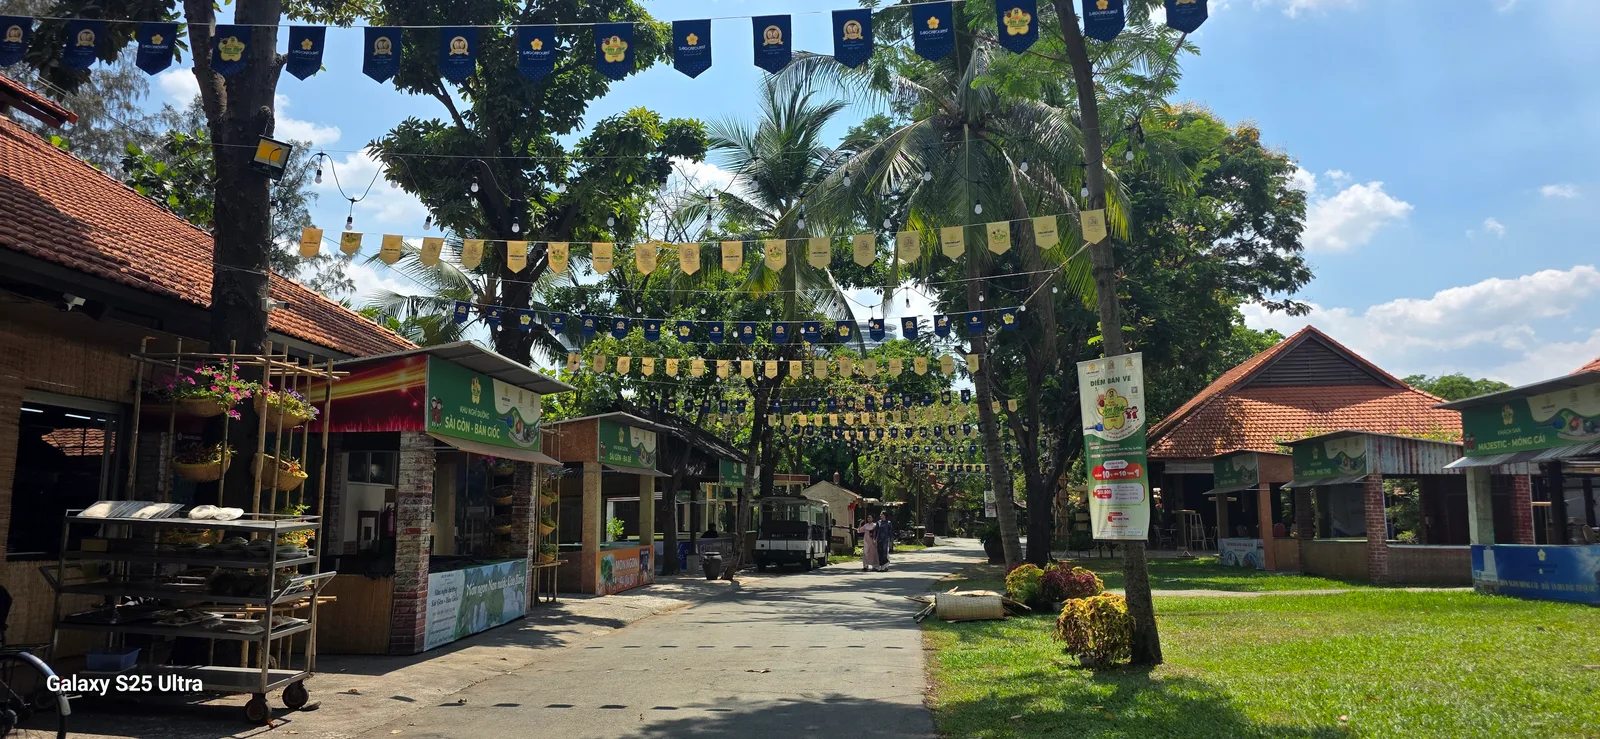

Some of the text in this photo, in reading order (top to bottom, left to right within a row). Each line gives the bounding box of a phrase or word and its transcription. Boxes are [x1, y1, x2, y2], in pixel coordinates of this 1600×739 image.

[460, 406, 468, 414] KHU
[444, 414, 455, 429] SÀI
[456, 417, 470, 432] GÒN
[487, 424, 500, 438] GIỐC
[1478, 440, 1507, 450] MAJESTIC
[1512, 436, 1532, 446] MÓNG
[1533, 432, 1545, 444] CÁI
